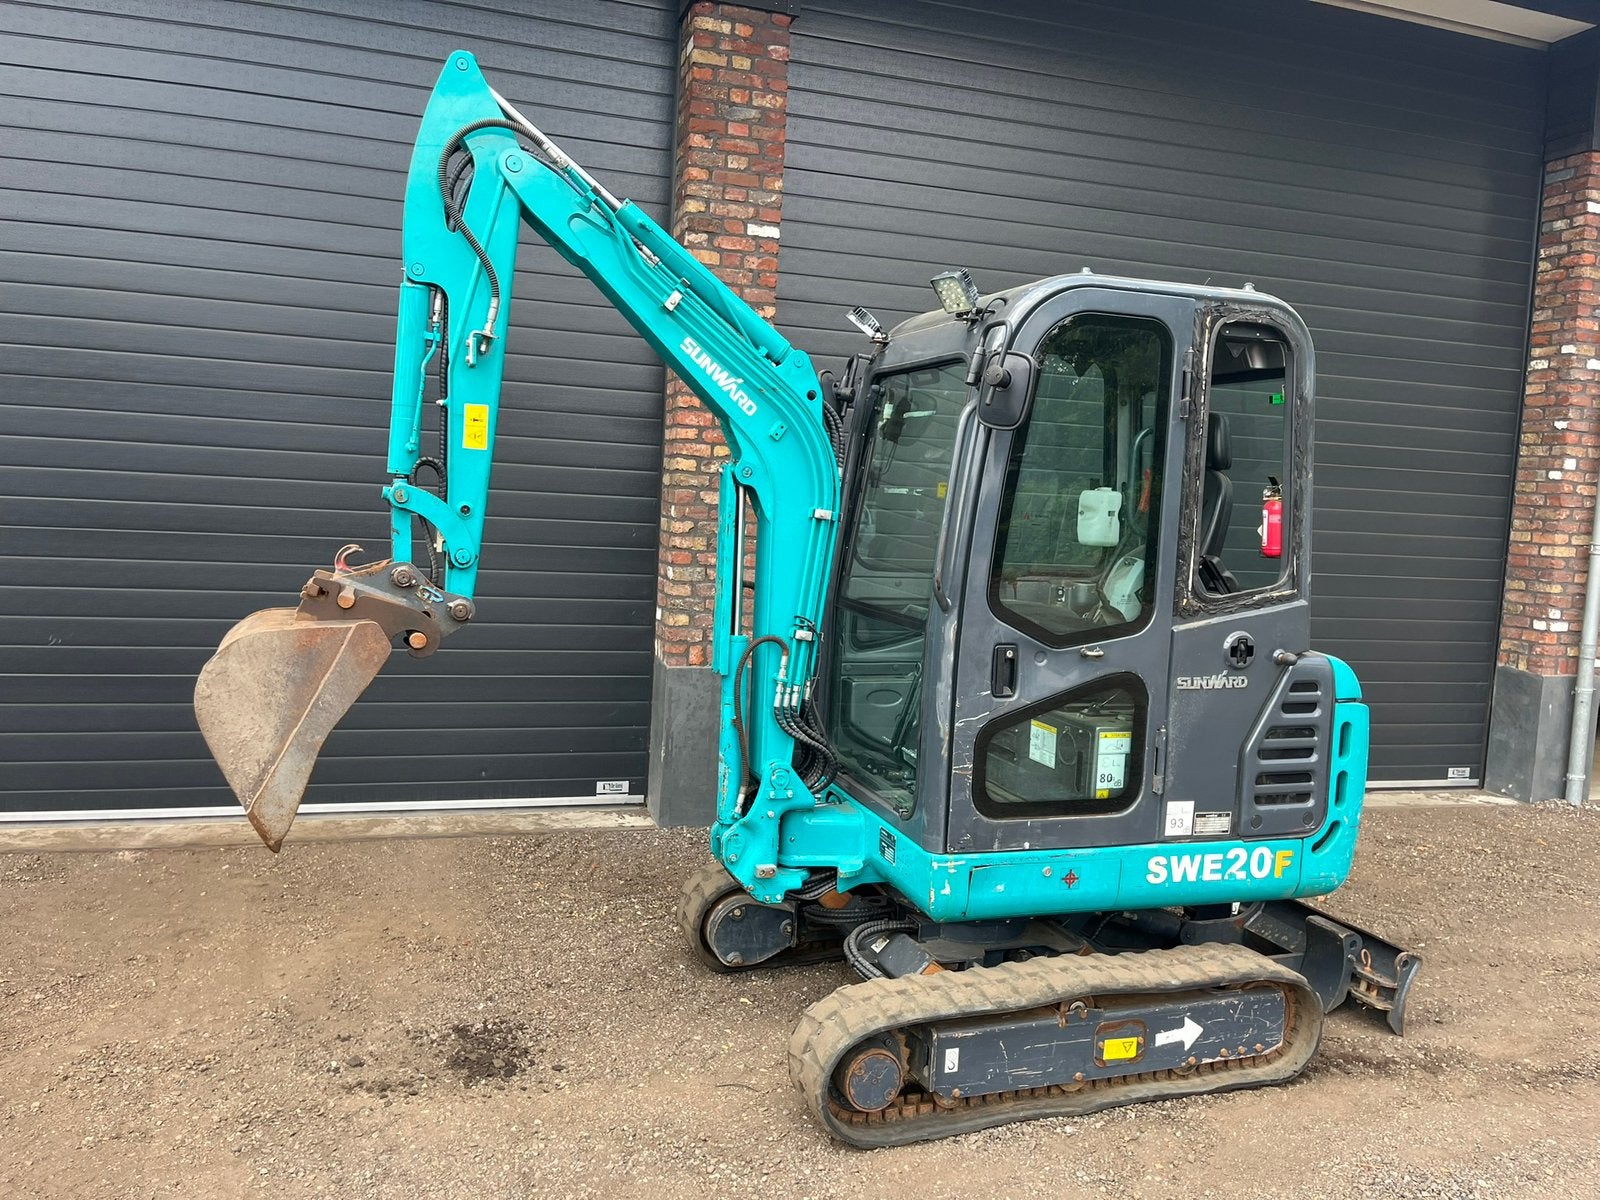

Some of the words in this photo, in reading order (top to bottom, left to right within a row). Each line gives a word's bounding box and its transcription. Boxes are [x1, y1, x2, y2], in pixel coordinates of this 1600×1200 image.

[680, 337, 757, 416] SUNWARD
[1176, 670, 1248, 690] SUNWARD
[1099, 773, 1113, 783] 80
[1170, 818, 1184, 829] 93
[1145, 846, 1294, 885] SWE20F
